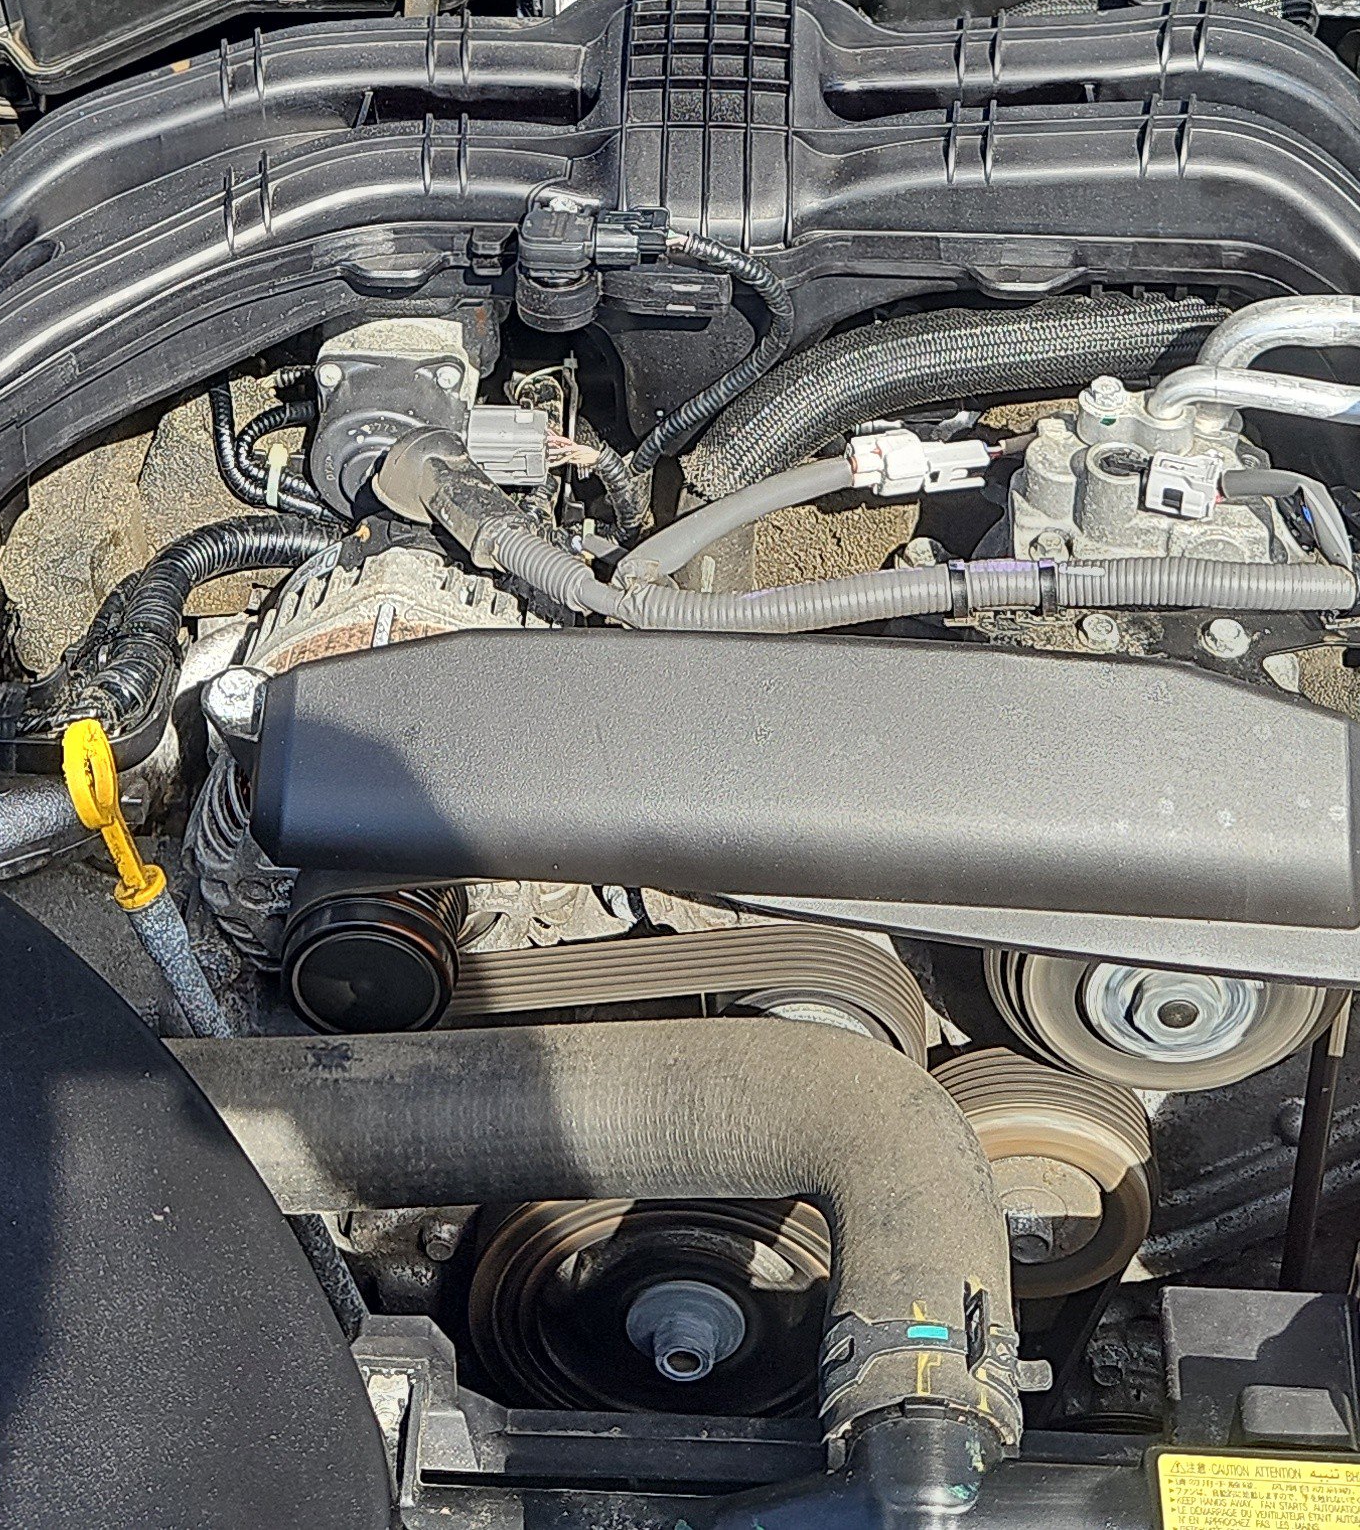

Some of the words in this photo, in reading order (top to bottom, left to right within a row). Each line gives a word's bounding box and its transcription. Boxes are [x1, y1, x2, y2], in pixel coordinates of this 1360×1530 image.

[1211, 1463, 1249, 1476] CAUTION
[1255, 1466, 1301, 1479] ATTENTION
[1177, 1497, 1196, 1505] KEEP
[1200, 1498, 1227, 1506] HANDS
[1261, 1501, 1276, 1509] FAN
[1279, 1502, 1308, 1511] STARTS
